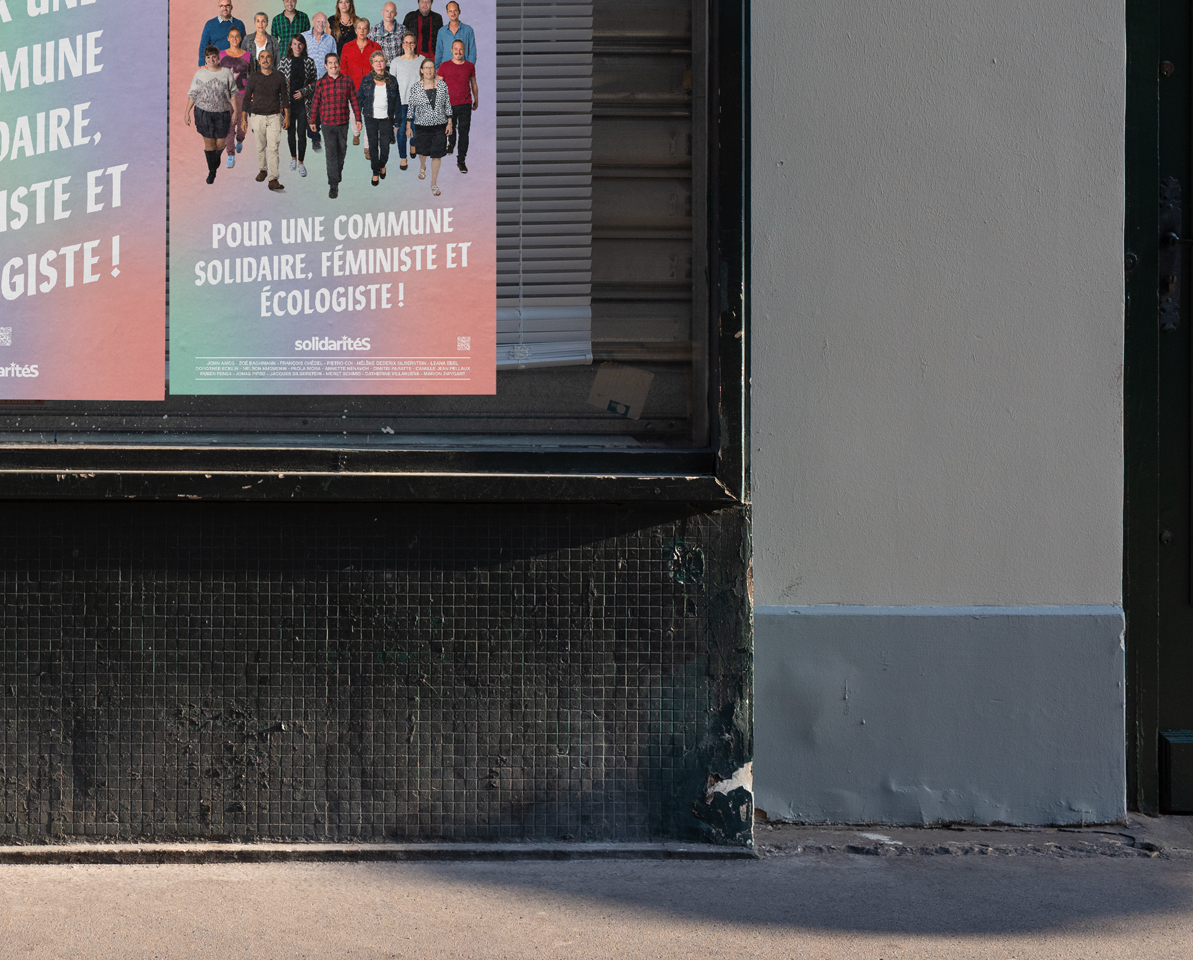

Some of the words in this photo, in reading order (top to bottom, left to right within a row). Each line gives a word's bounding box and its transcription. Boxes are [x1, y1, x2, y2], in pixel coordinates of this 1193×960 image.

[87, 163, 129, 214] ET
[212, 220, 273, 249] POUR
[281, 216, 325, 244] UNE
[334, 207, 454, 240] COMMUNE
[111, 235, 120, 278] !
[194, 253, 313, 286] SOLIDAIRE,
[322, 244, 437, 277] FÉMINISTE
[446, 242, 472, 268] ET
[261, 283, 392, 317] ÉCOLOGISTE
[398, 283, 404, 307] !
